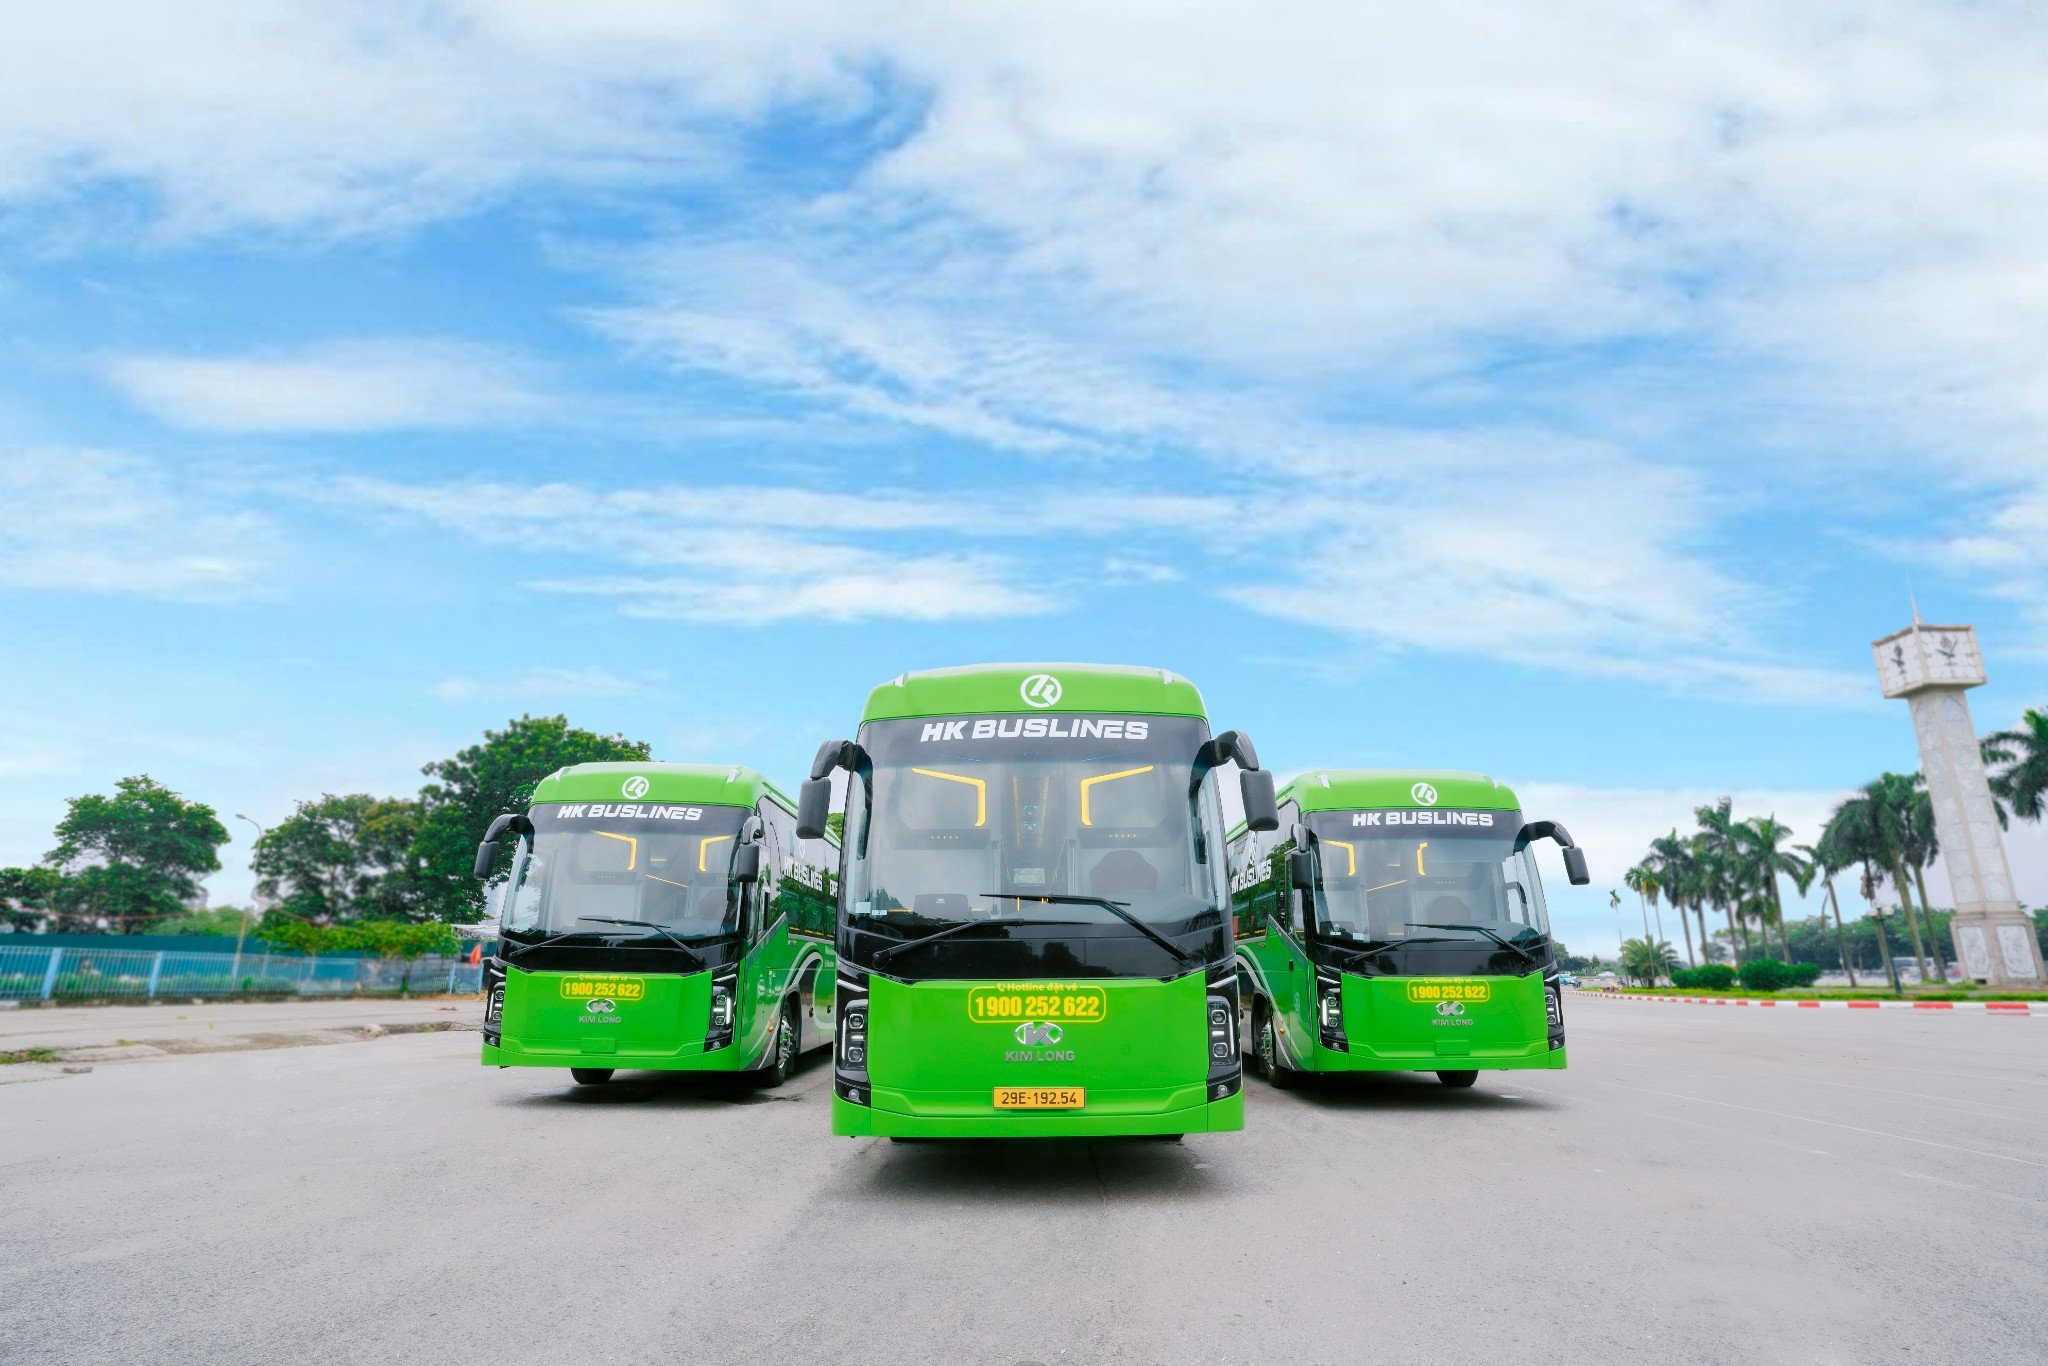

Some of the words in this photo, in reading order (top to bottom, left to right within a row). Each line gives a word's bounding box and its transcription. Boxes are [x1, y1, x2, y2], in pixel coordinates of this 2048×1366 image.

[920, 721, 969, 742] HK
[972, 718, 1149, 740] BUSLINES
[557, 804, 588, 819] HK
[587, 804, 703, 821] BUSLINES
[1352, 812, 1382, 827] HK
[1385, 811, 1494, 827] BUSLINES
[565, 982, 593, 995] 1900
[594, 983, 616, 996] 252
[617, 983, 640, 997] 622
[1007, 982, 1044, 991] Hotline
[1046, 982, 1063, 993] đặt
[1065, 982, 1078, 992] vé
[1411, 986, 1440, 998] 1900
[1441, 986, 1463, 999] 252
[1464, 986, 1486, 998] 622
[975, 996, 1022, 1016] 1900
[1025, 996, 1060, 1016] 252
[1063, 996, 1099, 1016] 622
[579, 1015, 596, 1023] KIM
[598, 1016, 621, 1024] LONG
[1005, 1051, 1032, 1061] KIM
[1036, 1051, 1075, 1061] LONG
